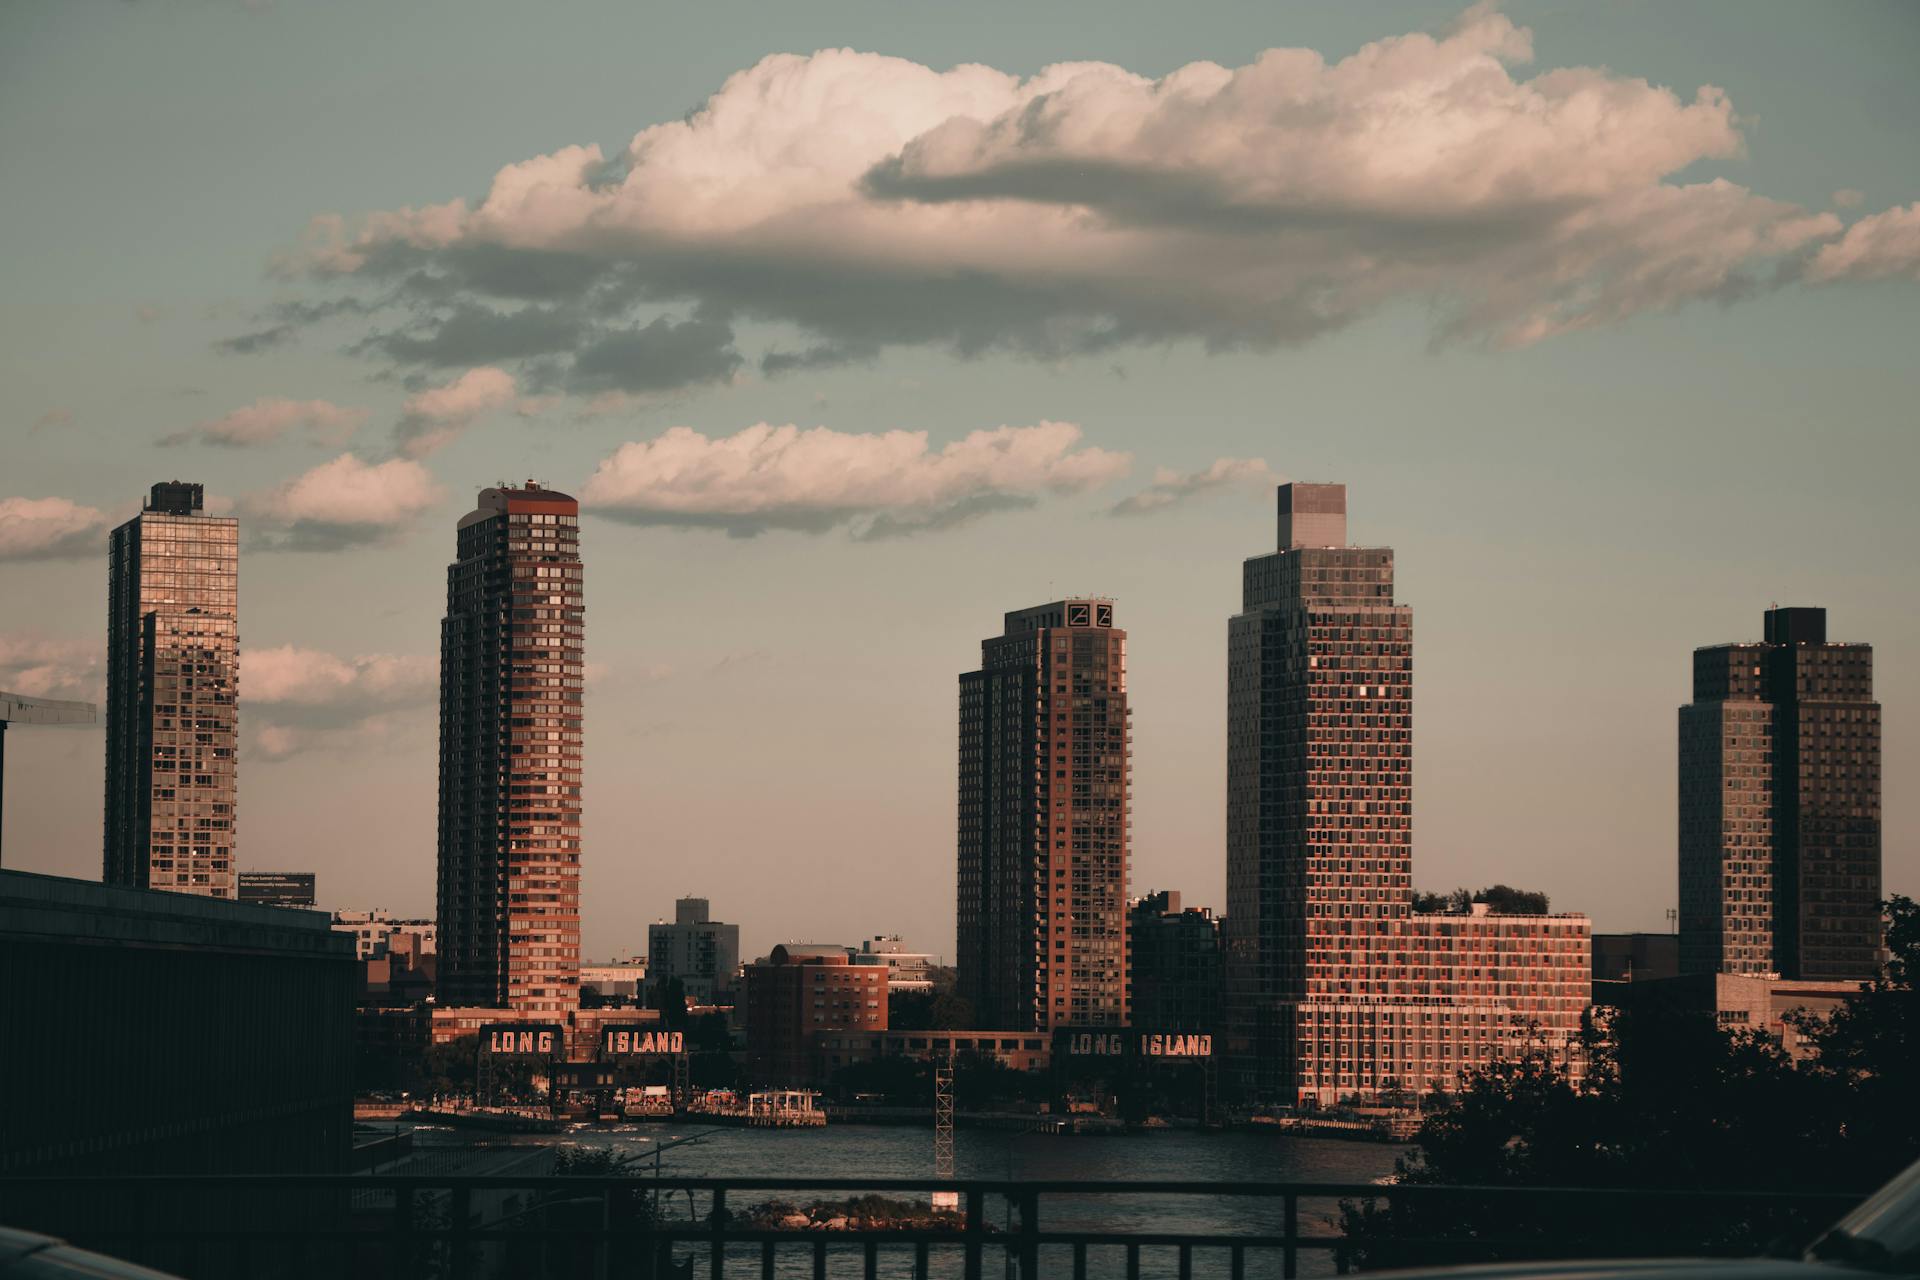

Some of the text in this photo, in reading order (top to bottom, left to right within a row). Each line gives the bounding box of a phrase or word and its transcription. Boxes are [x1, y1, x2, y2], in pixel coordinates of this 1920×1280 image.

[491, 1031, 684, 1053] LONG ISLAND
[1070, 1033, 1213, 1056] LONG ISLAND
